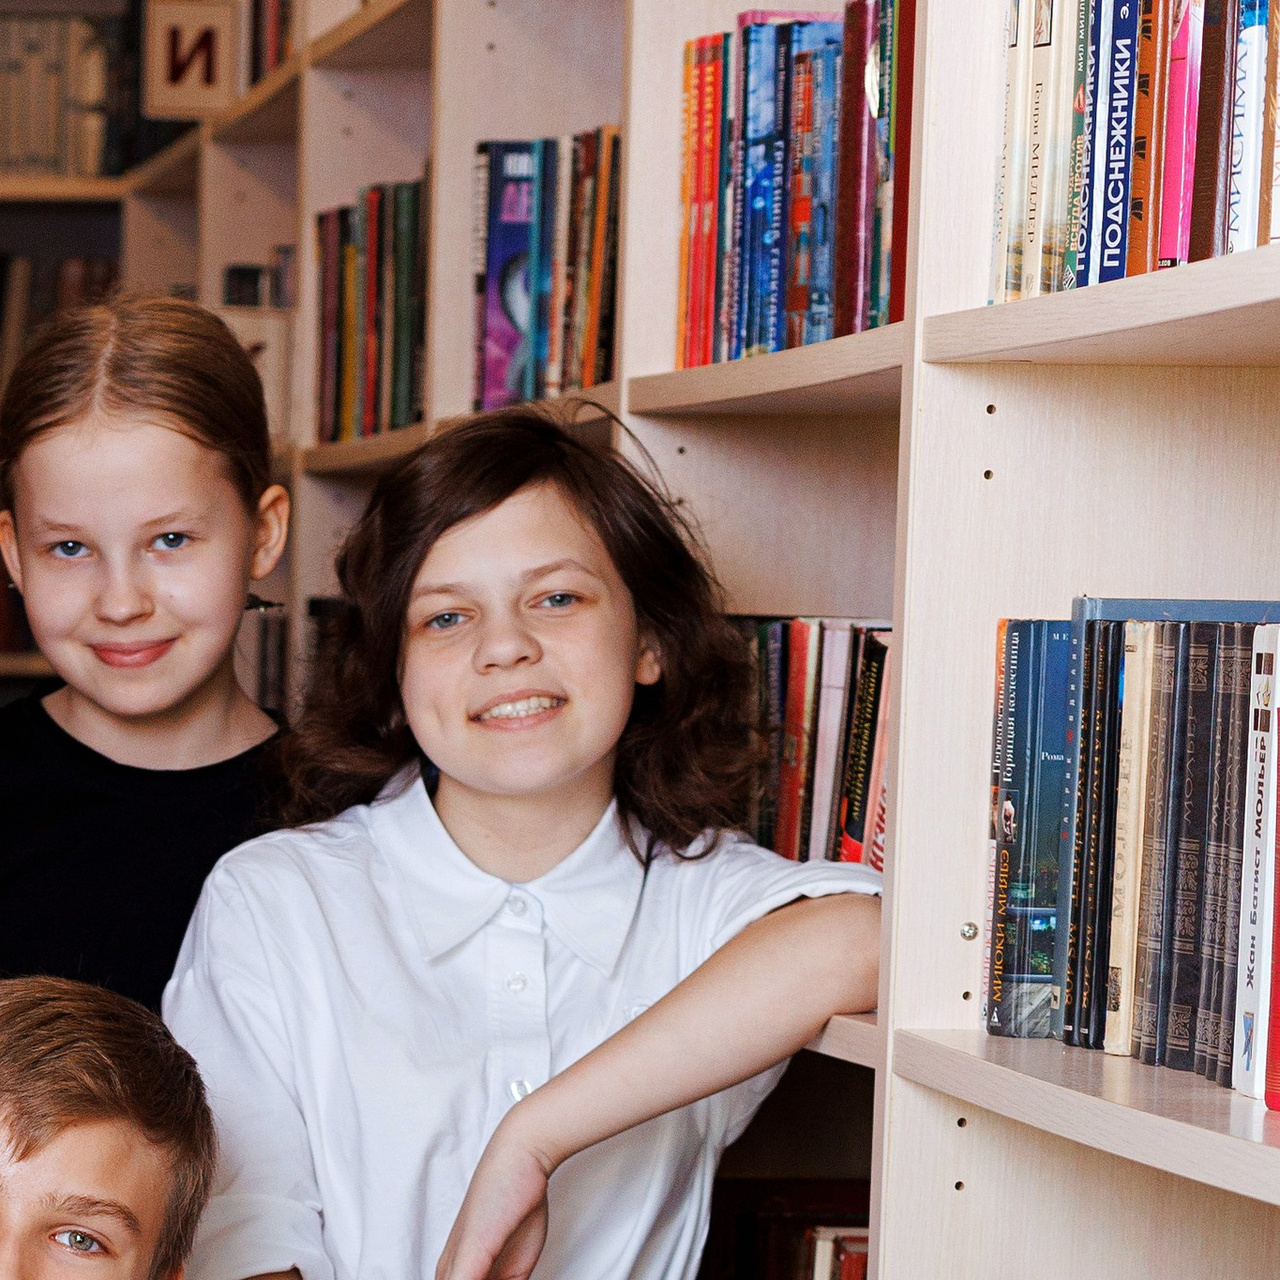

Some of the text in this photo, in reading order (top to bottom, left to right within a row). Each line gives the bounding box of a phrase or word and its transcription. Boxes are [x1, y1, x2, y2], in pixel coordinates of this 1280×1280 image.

[168, 25, 215, 85] И
[1027, 143, 1040, 243] МИЛЛЕР
[1070, 134, 1084, 251] ВСЕГДА ПРОТИВ
[1103, 39, 1131, 267] ПОДСНЕЖНИКИ
[1003, 632, 1019, 783] Горящая колесница
[1183, 705, 1196, 826] МОЛЬЕР
[993, 849, 1010, 1003] МИЮКИ МИЯБЭ
[1246, 736, 1266, 990] Жан Батист МОЛЬЕР
